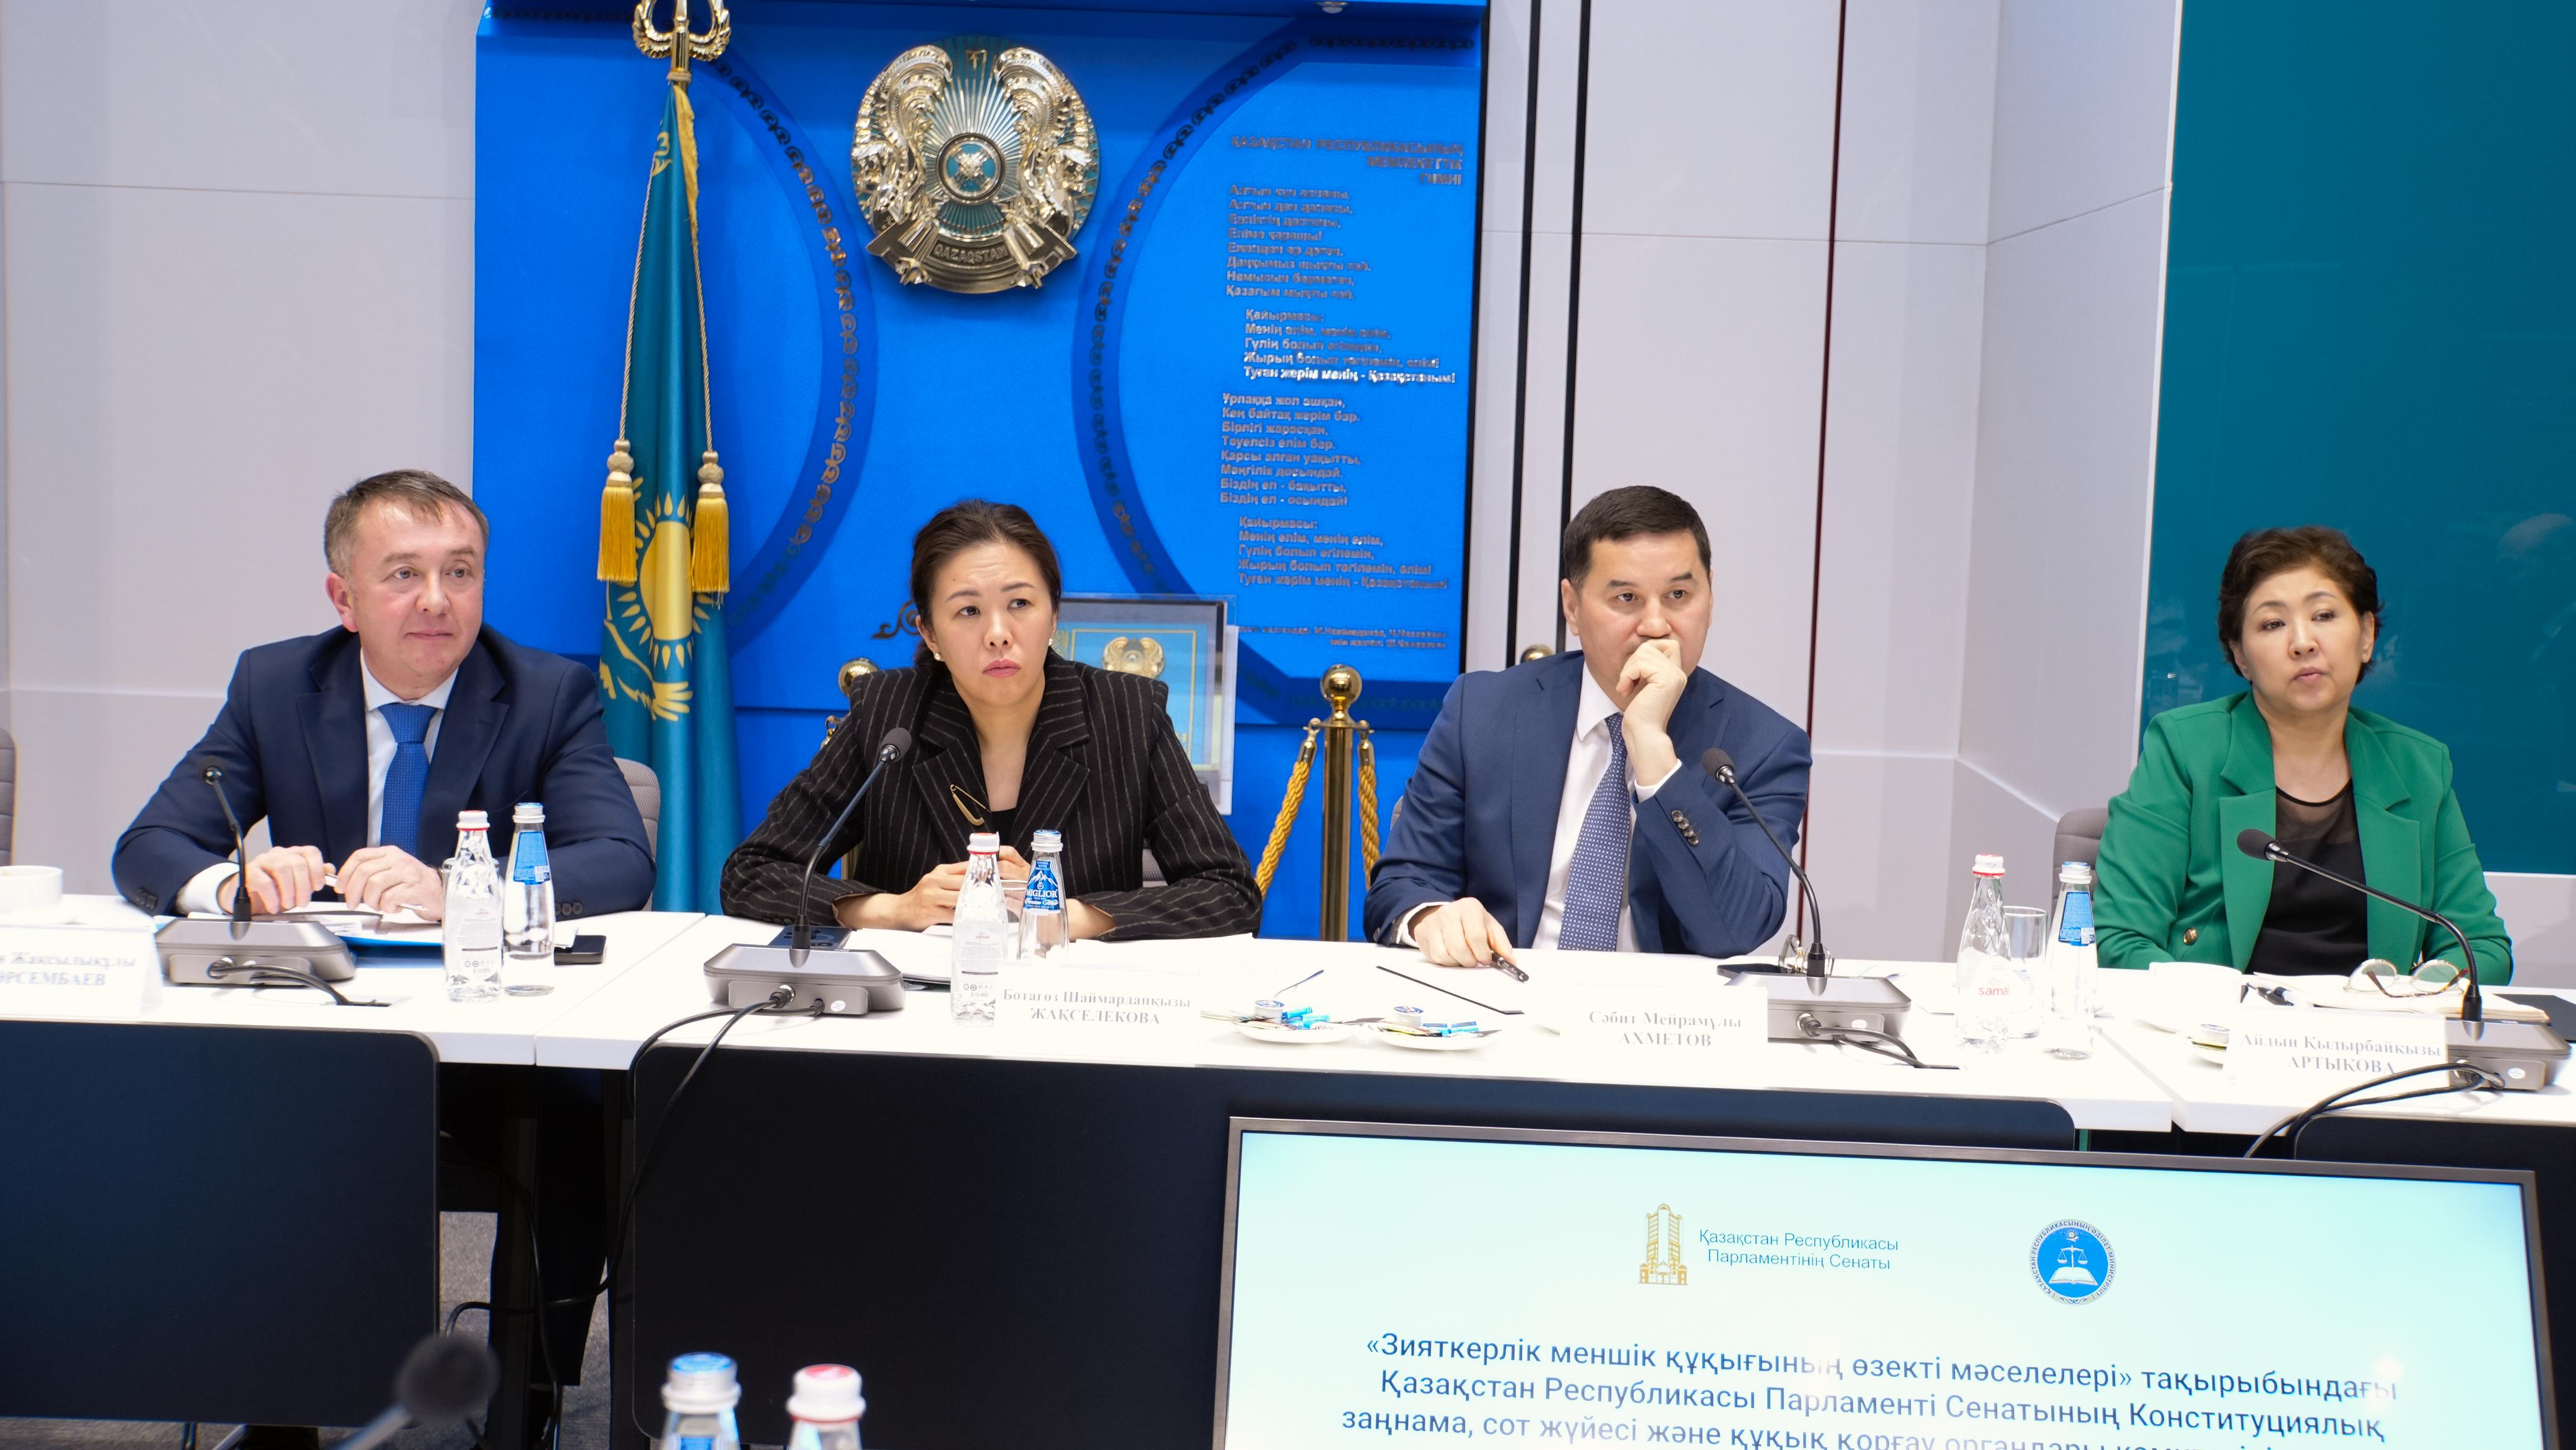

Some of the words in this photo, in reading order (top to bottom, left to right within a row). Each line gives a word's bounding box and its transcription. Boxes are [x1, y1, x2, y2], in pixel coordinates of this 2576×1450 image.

[933, 243, 1009, 264] QAZAQSTAN
[1026, 889, 1058, 898] MIGLIOR
[1589, 1010, 1637, 1024] Сәбит
[1620, 1031, 1712, 1047] АХМЕТОВ
[2241, 1033, 2298, 1047] Айдын
[1699, 1229, 1778, 1246] Қазақстан
[1785, 1233, 1898, 1251] Республикасы
[2032, 1221, 2091, 1256] РЕСПУБЛИКАСЫНЫҢ
[2091, 1228, 2111, 1250] ӘДІЛЕТ
[1708, 1249, 1824, 1269] Парламентінің
[1830, 1254, 1890, 1269] Сенаты
[2094, 1252, 2115, 1297] МИНИСТРЛІГІ
[1367, 1332, 1541, 1366] «Зияткерлік
[1551, 1343, 1656, 1368] меншік
[1666, 1351, 1843, 1380] құқығының
[1853, 1356, 1940, 1379] өзекті
[1952, 1363, 2132, 1393] мәселелері»
[2141, 1370, 2396, 1403] тақырыбындағы
[1382, 1369, 1534, 1401] Қазақстан
[1546, 1377, 1755, 1409] Республикасы
[1767, 1387, 1935, 1417] Парламенті
[1946, 1395, 2120, 1431] Сенатының
[2130, 1403, 2386, 1444] Конституциялық
[1342, 1411, 1473, 1438] заңнама,
[1483, 1417, 1530, 1436] сот
[1539, 1416, 1636, 1444] жүйесі
[1647, 1425, 1720, 1445] және
[1731, 1428, 1827, 1450] құқық
